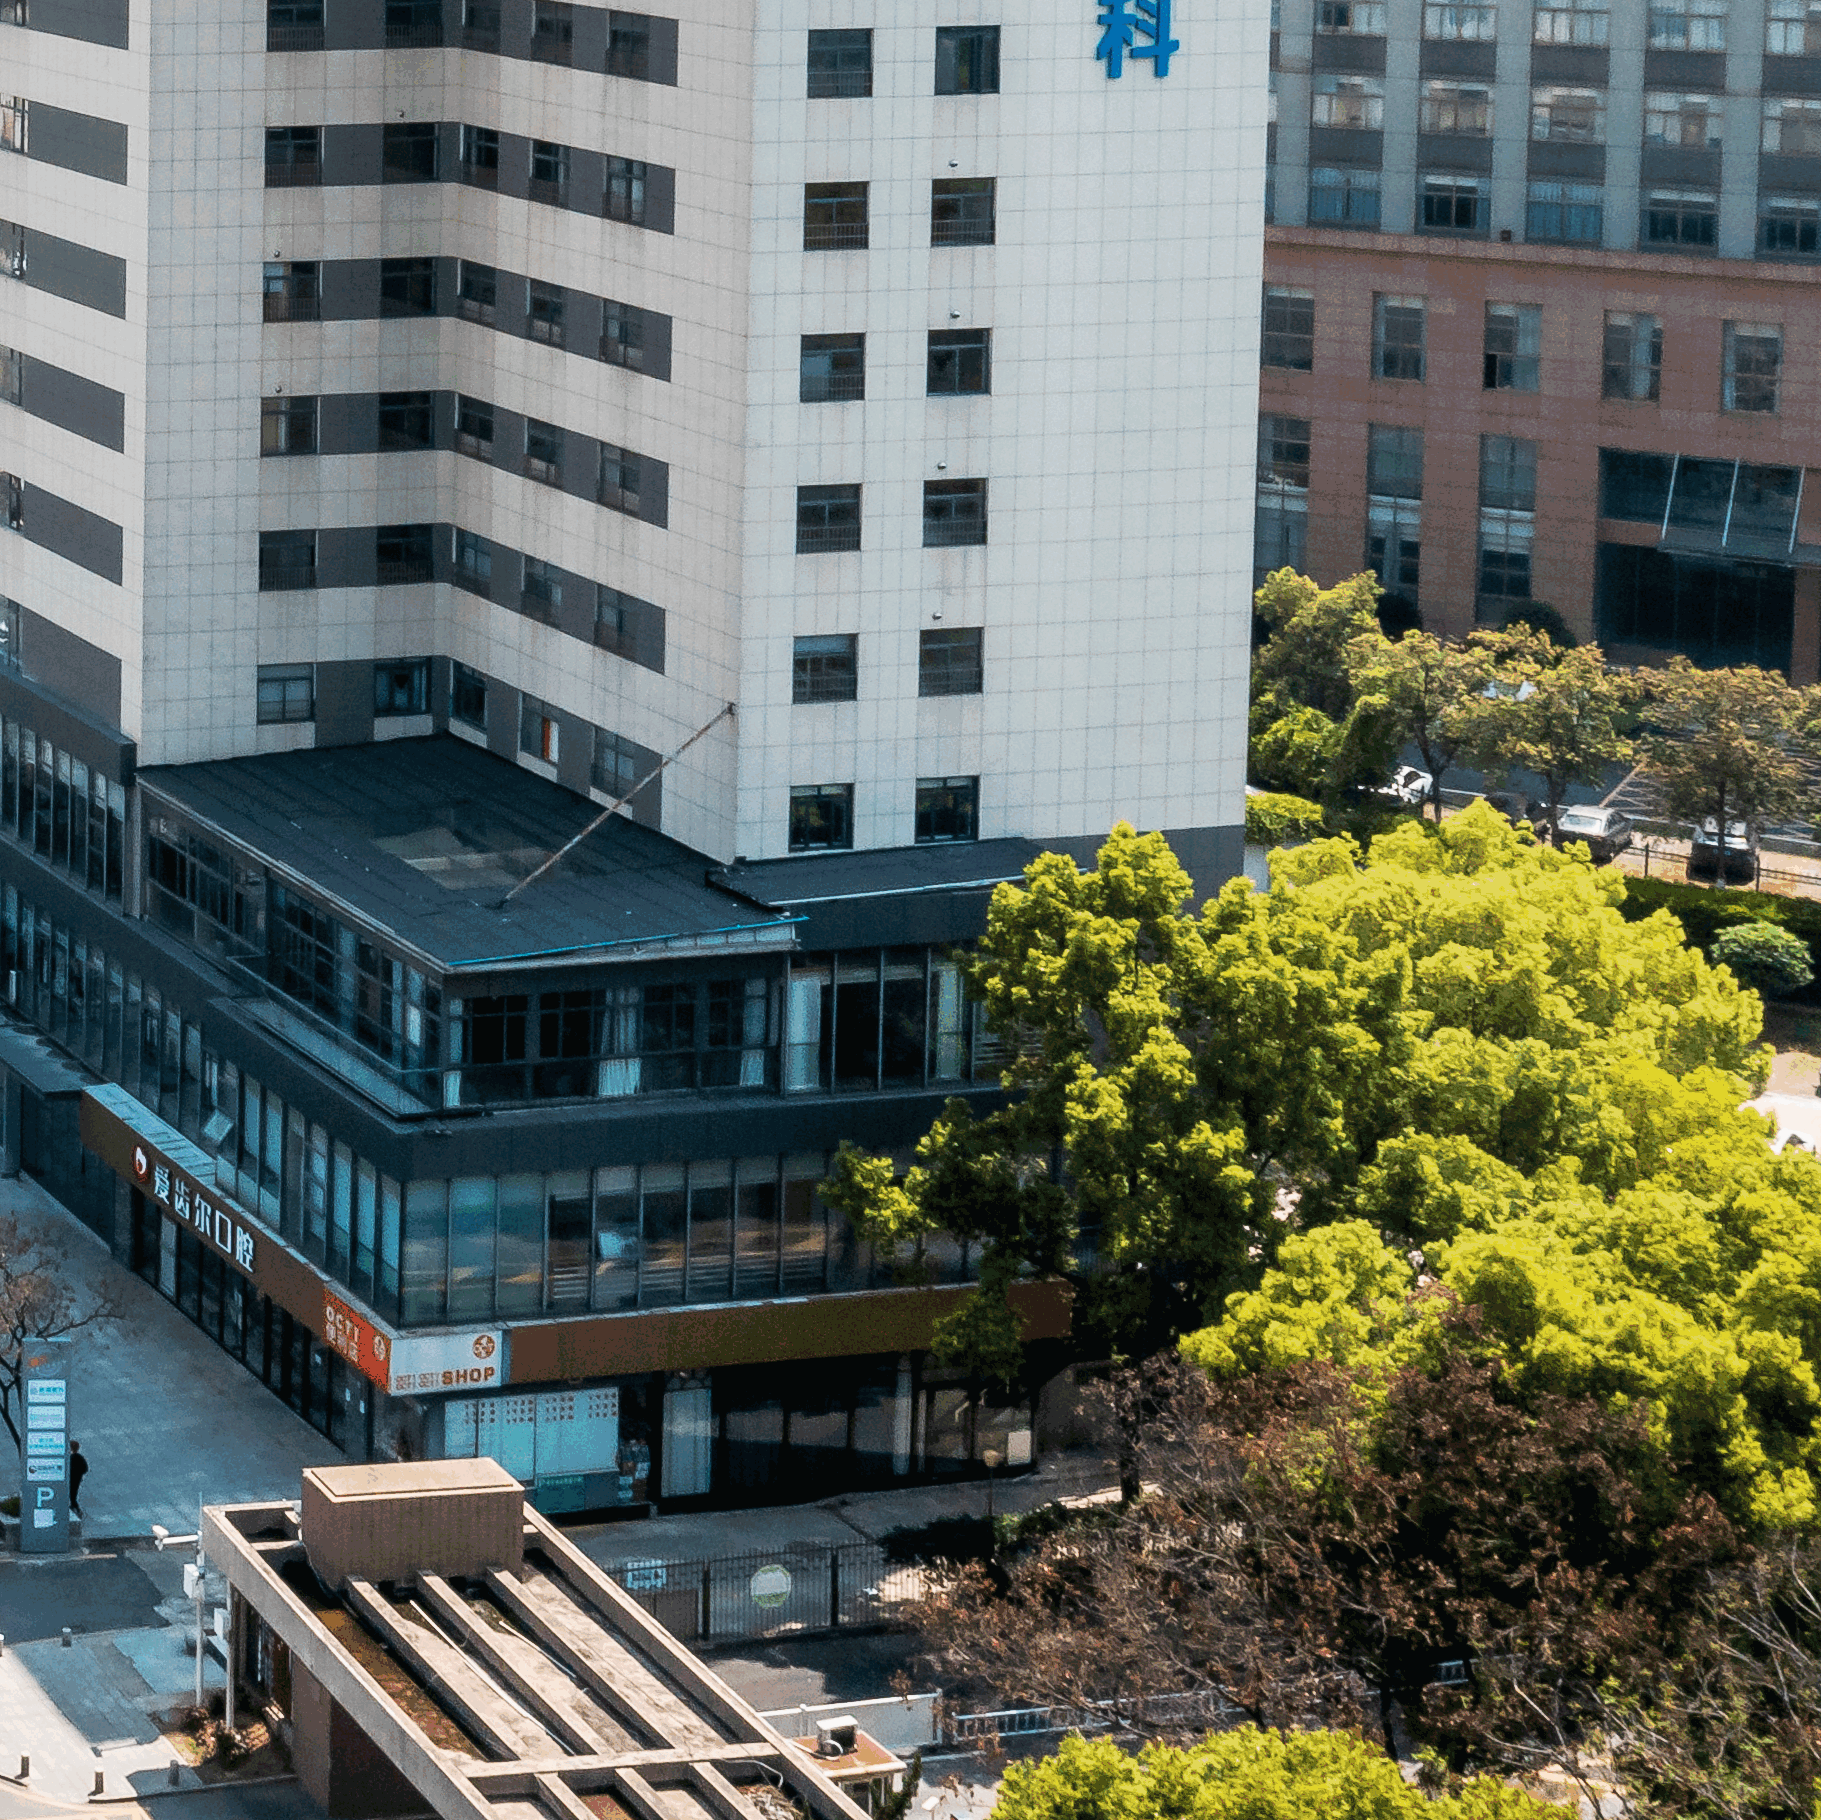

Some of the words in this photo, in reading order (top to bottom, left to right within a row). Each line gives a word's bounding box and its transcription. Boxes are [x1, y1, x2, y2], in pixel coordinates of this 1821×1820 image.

[155, 1162, 254, 1273] 爱齿尔口腔
[442, 1367, 495, 1385] SHOP
